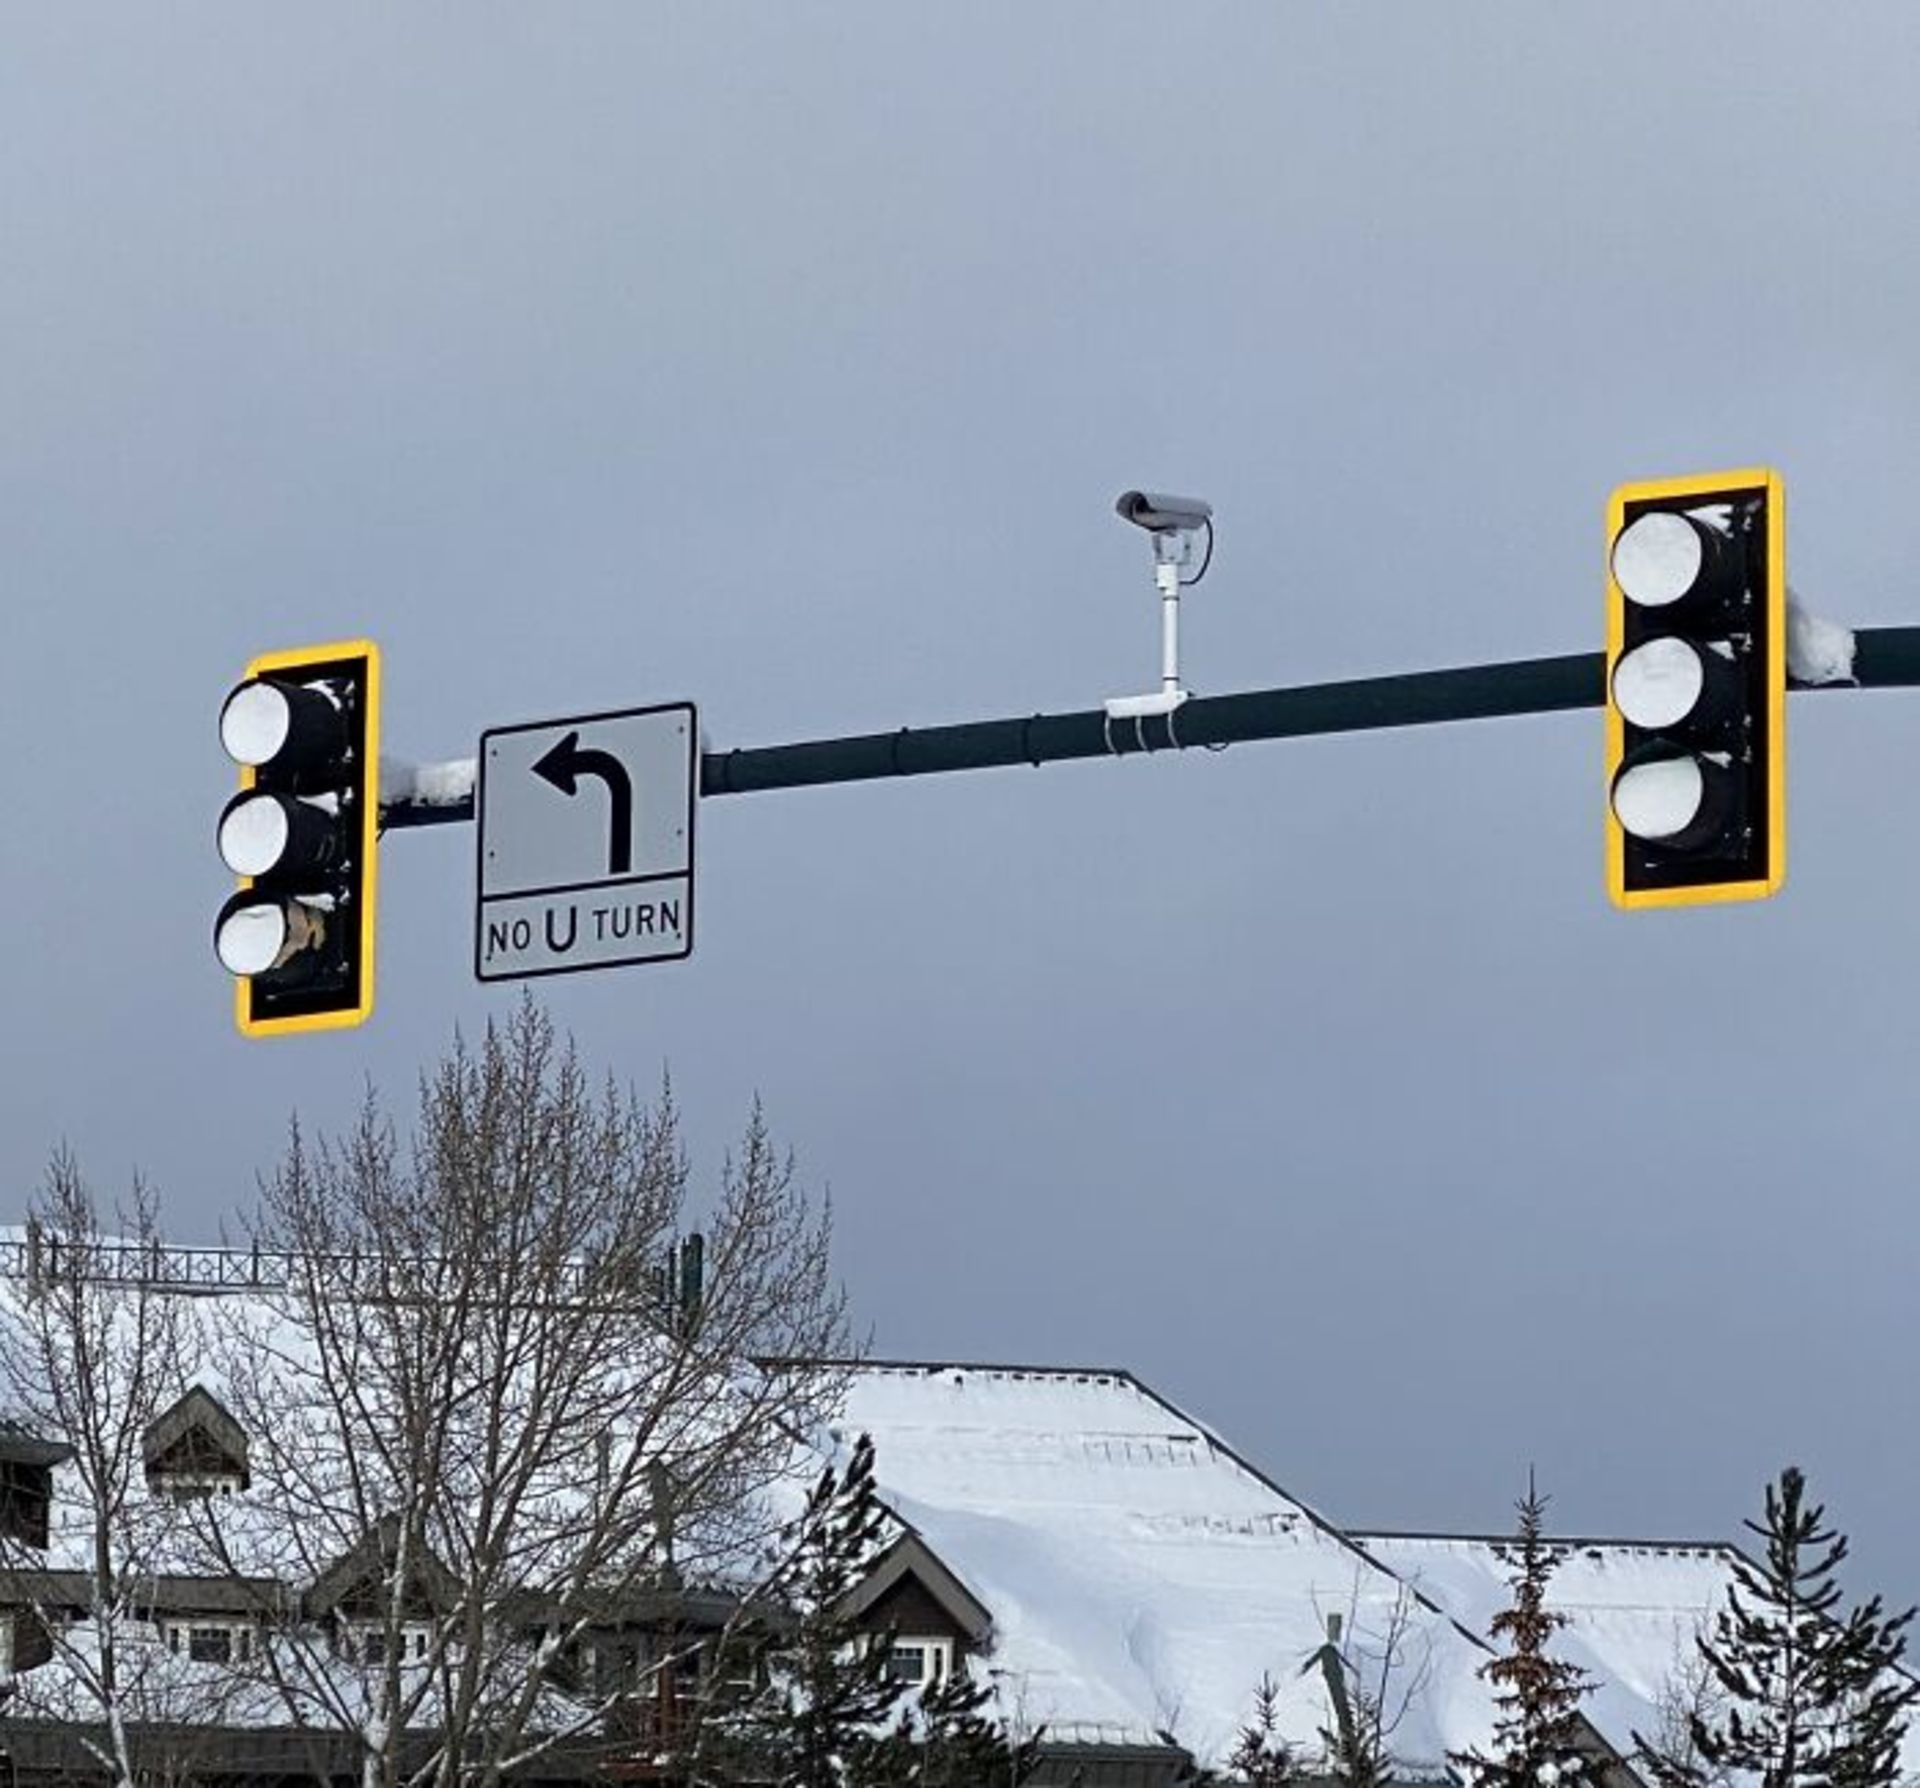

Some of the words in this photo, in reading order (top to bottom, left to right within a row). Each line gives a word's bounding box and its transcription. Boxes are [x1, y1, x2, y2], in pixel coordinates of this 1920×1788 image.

[489, 919, 531, 952] NO
[545, 905, 577, 953] U
[592, 899, 679, 941] TURN
